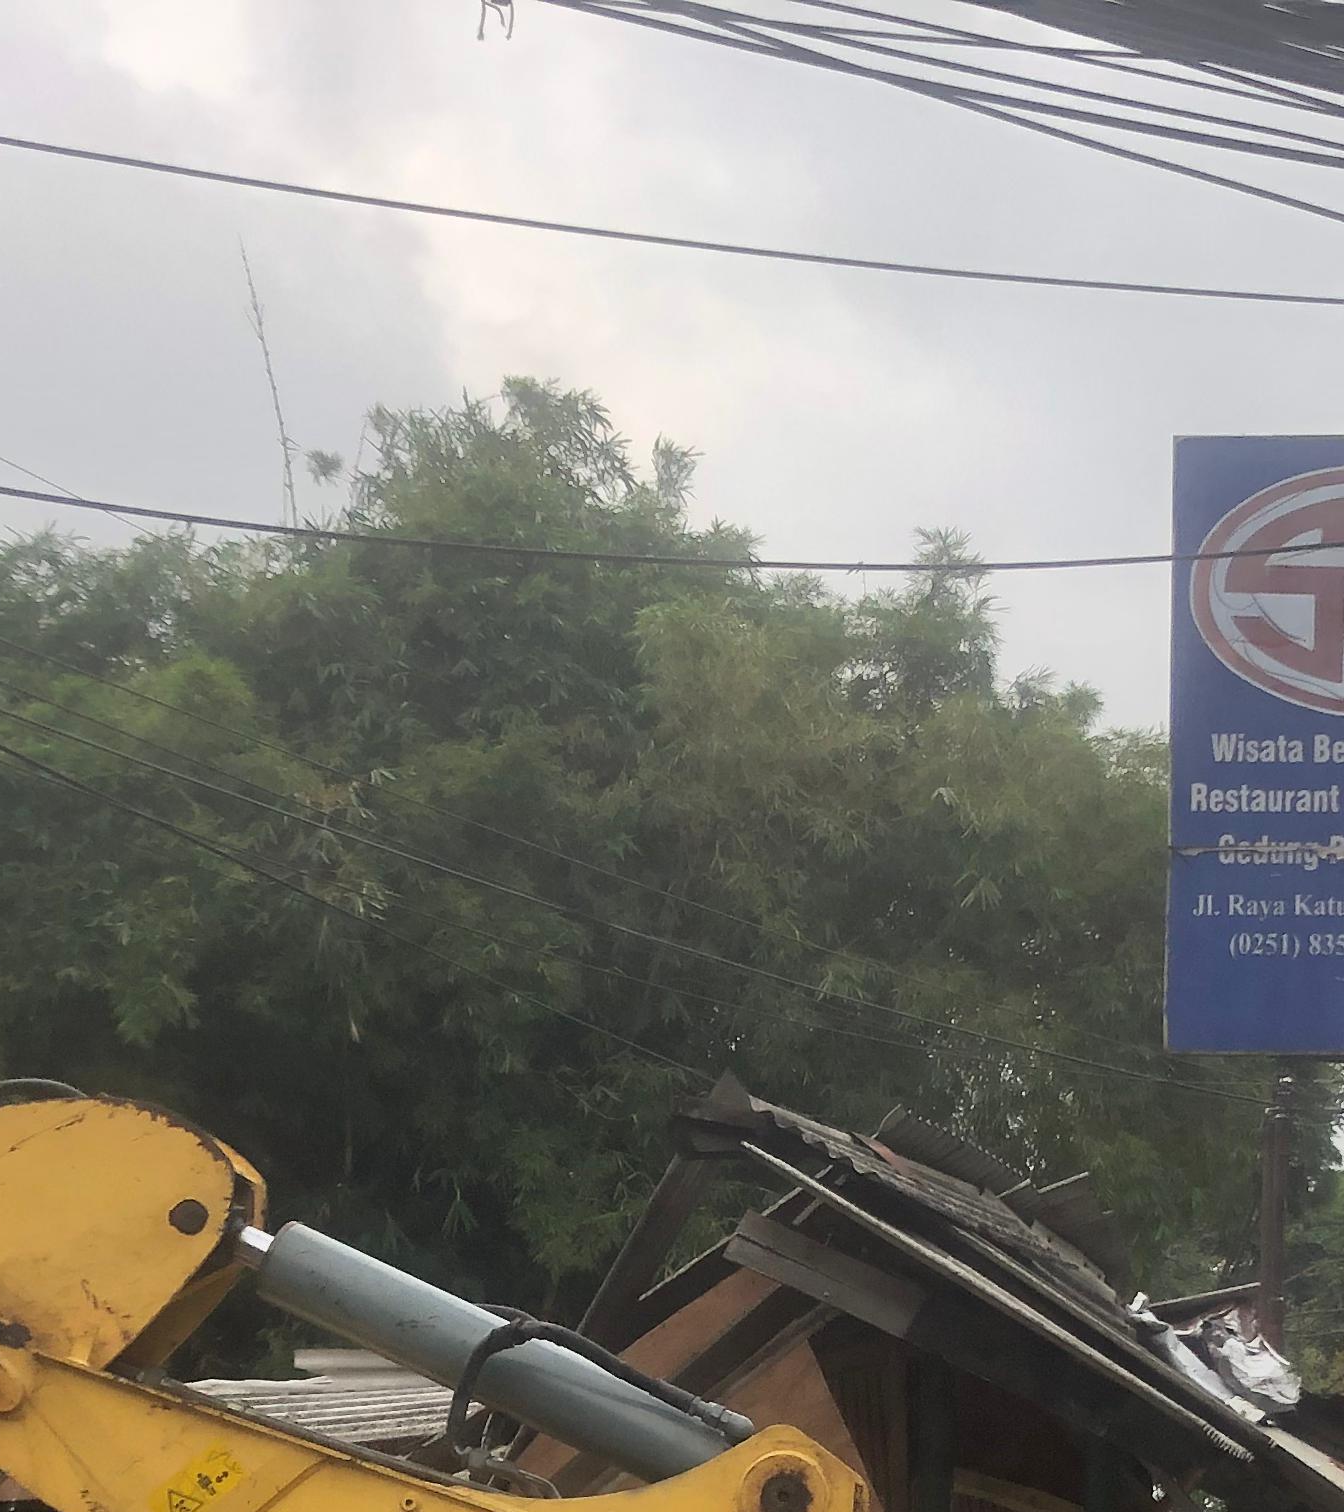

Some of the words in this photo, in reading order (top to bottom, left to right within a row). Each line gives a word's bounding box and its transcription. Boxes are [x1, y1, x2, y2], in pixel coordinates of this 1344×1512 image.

[1211, 733, 1304, 763] Wisata
[1190, 782, 1340, 813] Restaurant
[1192, 894, 1221, 916] Jl.
[1228, 894, 1285, 922] Raya
[1229, 933, 1300, 959] (0251)
